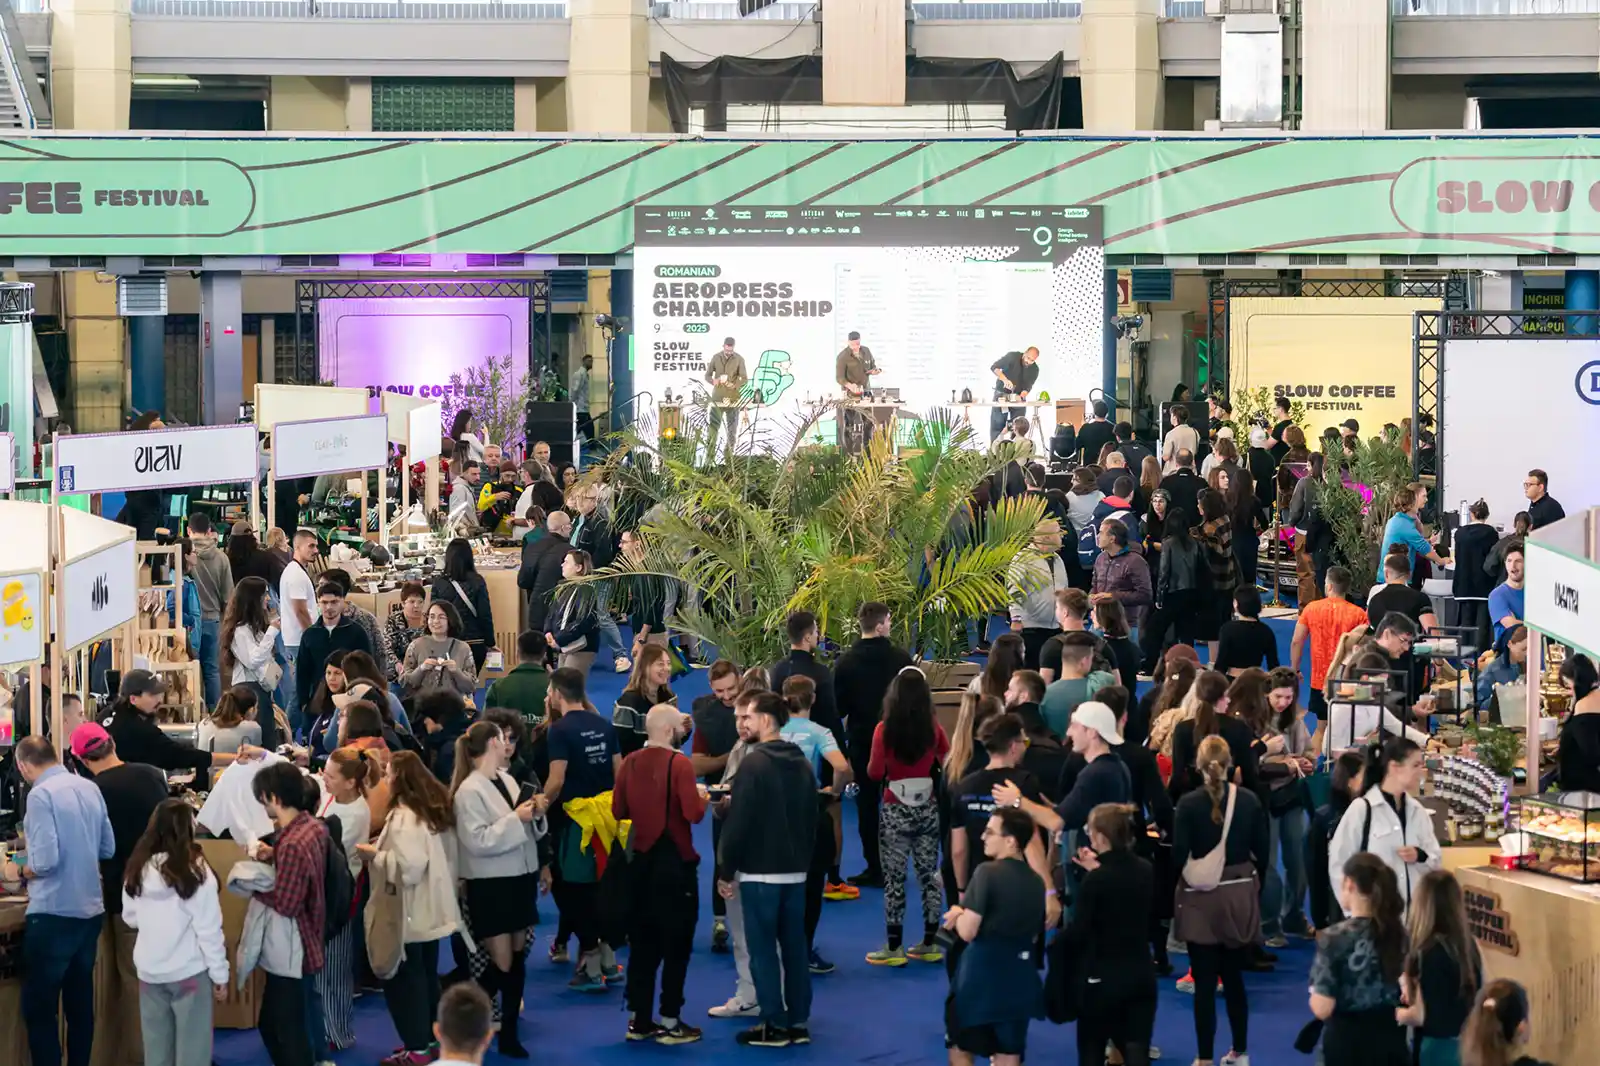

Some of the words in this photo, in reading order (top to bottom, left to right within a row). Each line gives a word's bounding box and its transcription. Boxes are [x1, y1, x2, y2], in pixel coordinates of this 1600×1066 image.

[94, 190, 209, 206] FESTIVAL
[1437, 180, 1574, 213] SLOW
[659, 267, 716, 276] ROMANIAN
[653, 282, 793, 299] AEROPRESS
[653, 300, 833, 317] CHAMPIONSHIP
[686, 324, 707, 332] 2025
[653, 342, 690, 350] SLOW
[654, 352, 703, 361] COFFEE
[654, 362, 708, 371] FESTIVA
[1274, 384, 1324, 397] SLOW
[1329, 385, 1396, 398] COFFEE
[1306, 402, 1363, 411] FESTIVAL
